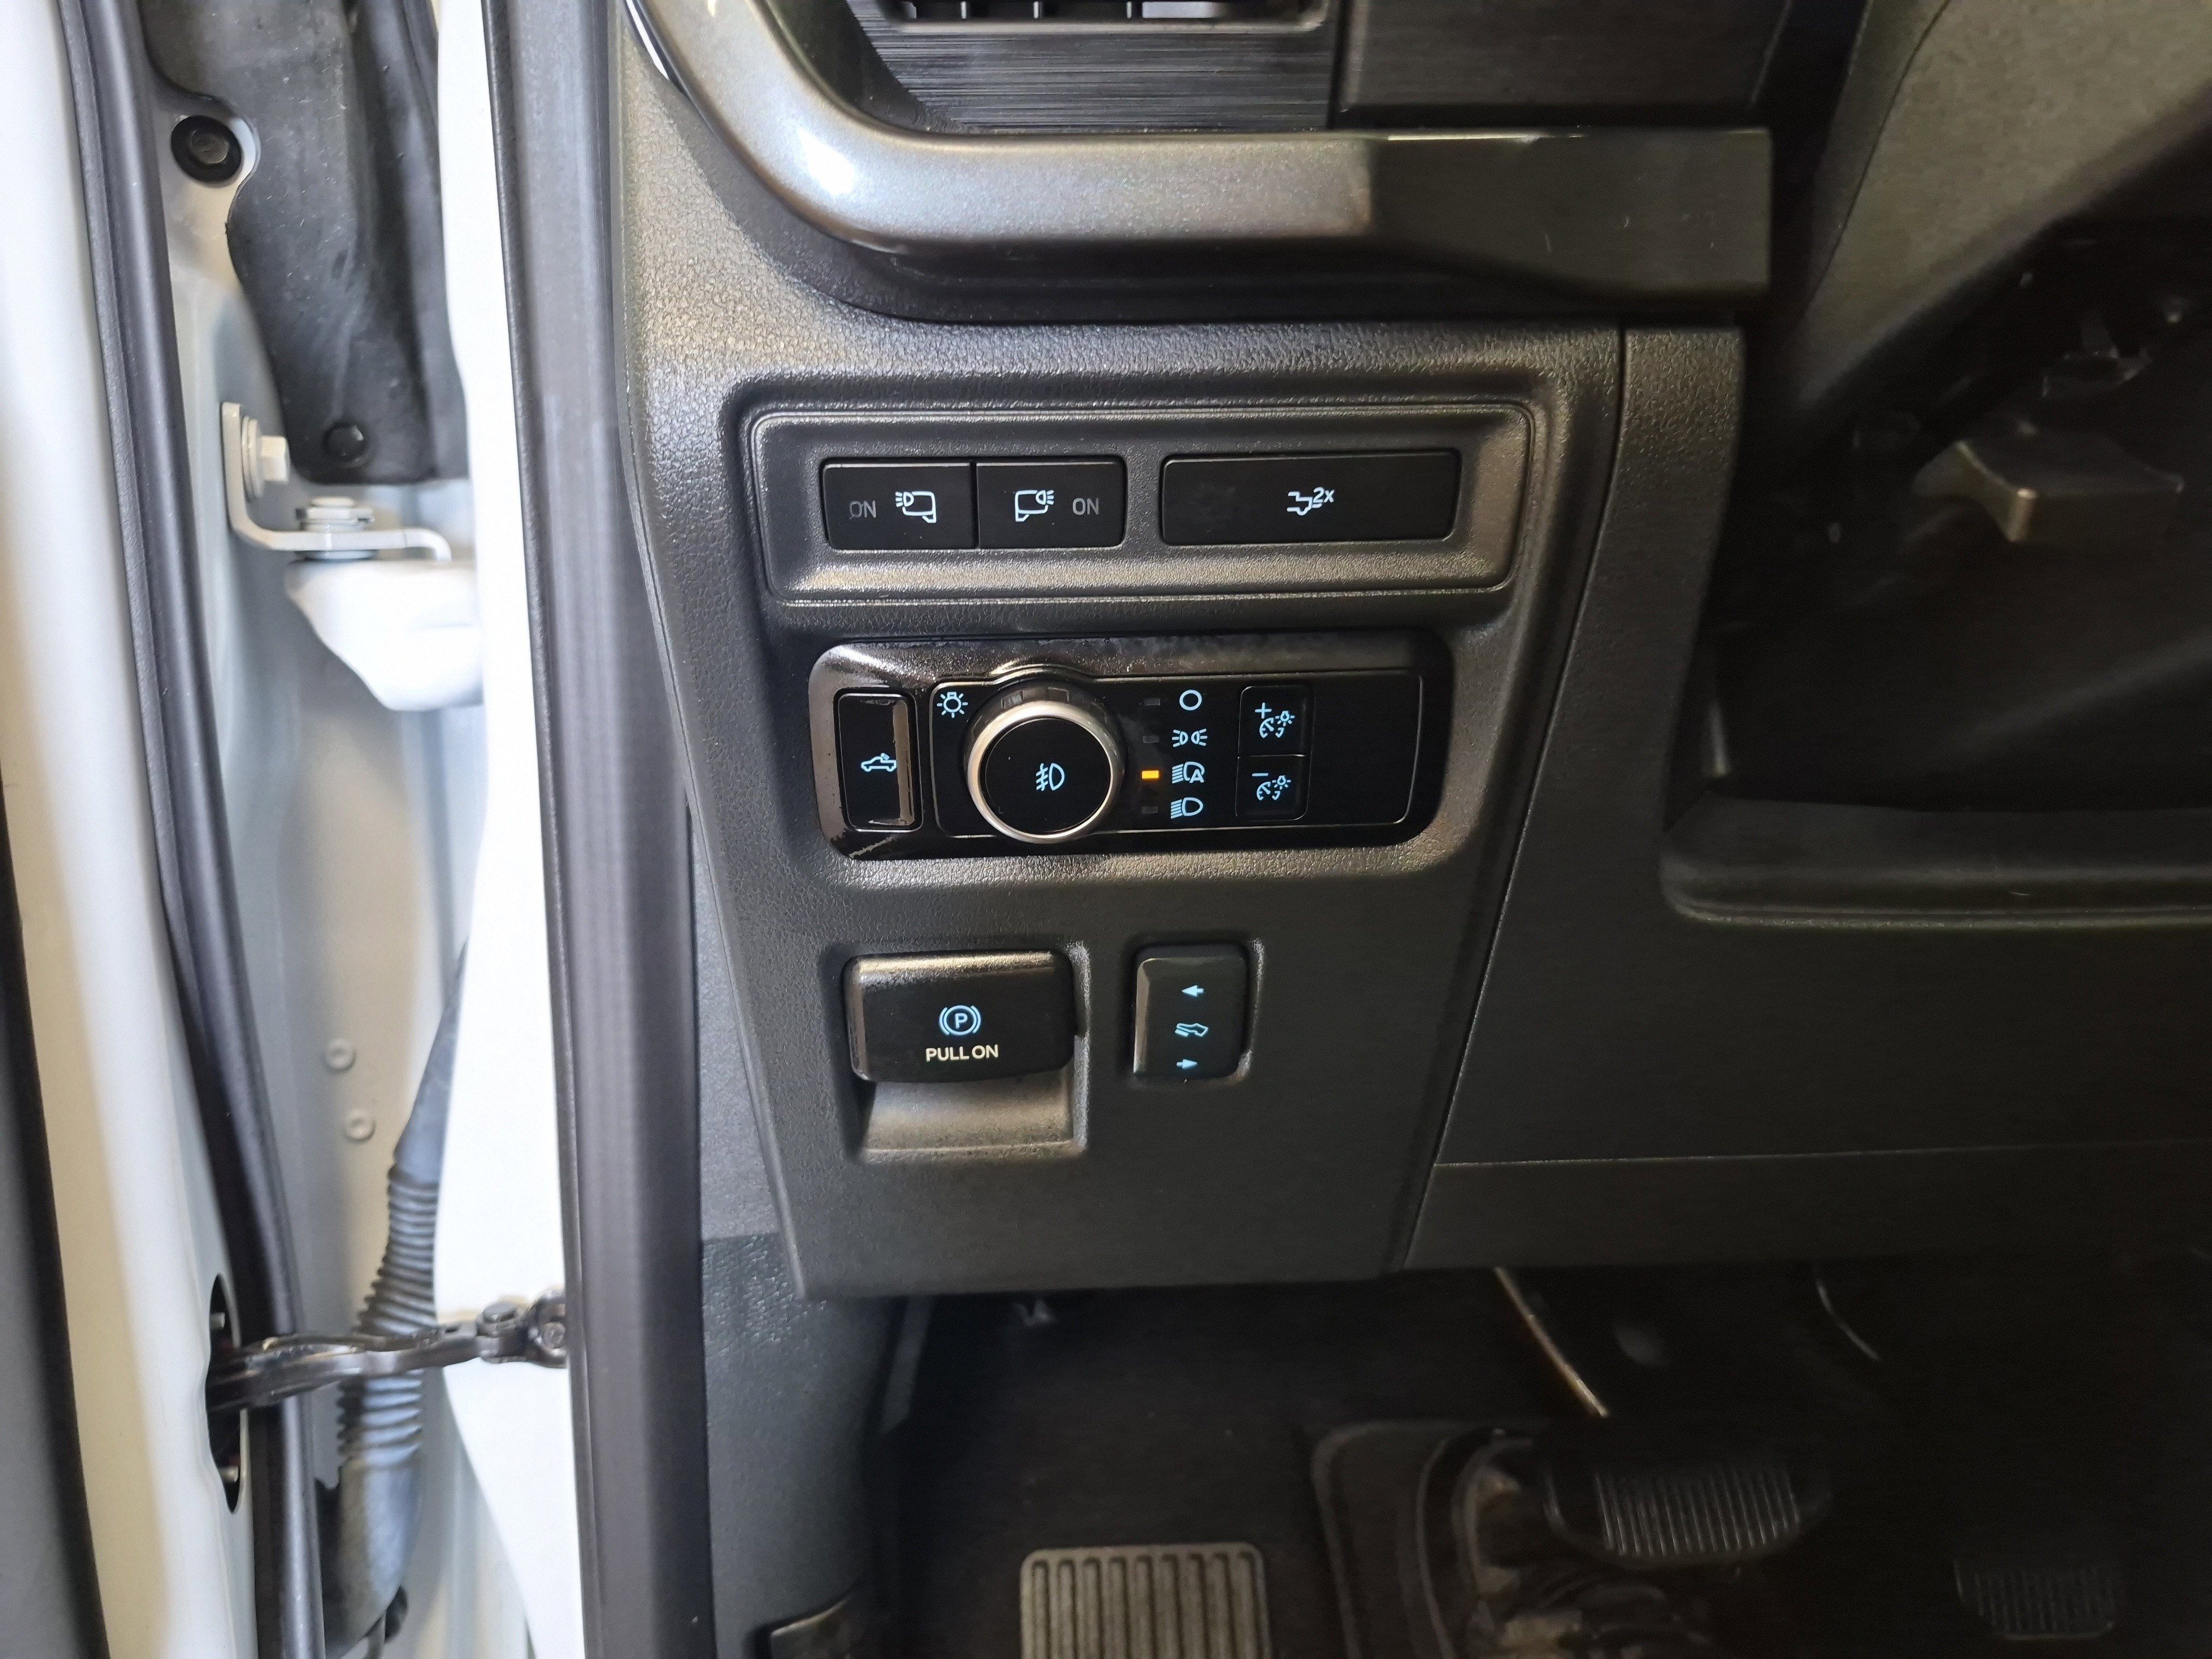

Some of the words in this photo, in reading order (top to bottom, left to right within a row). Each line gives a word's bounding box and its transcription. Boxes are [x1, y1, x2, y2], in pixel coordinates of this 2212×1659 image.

[850, 500, 876, 518] ON
[1072, 497, 1099, 516] ON
[955, 1012, 968, 1029] P
[925, 1046, 970, 1062] PULL
[972, 1044, 999, 1059] ON
